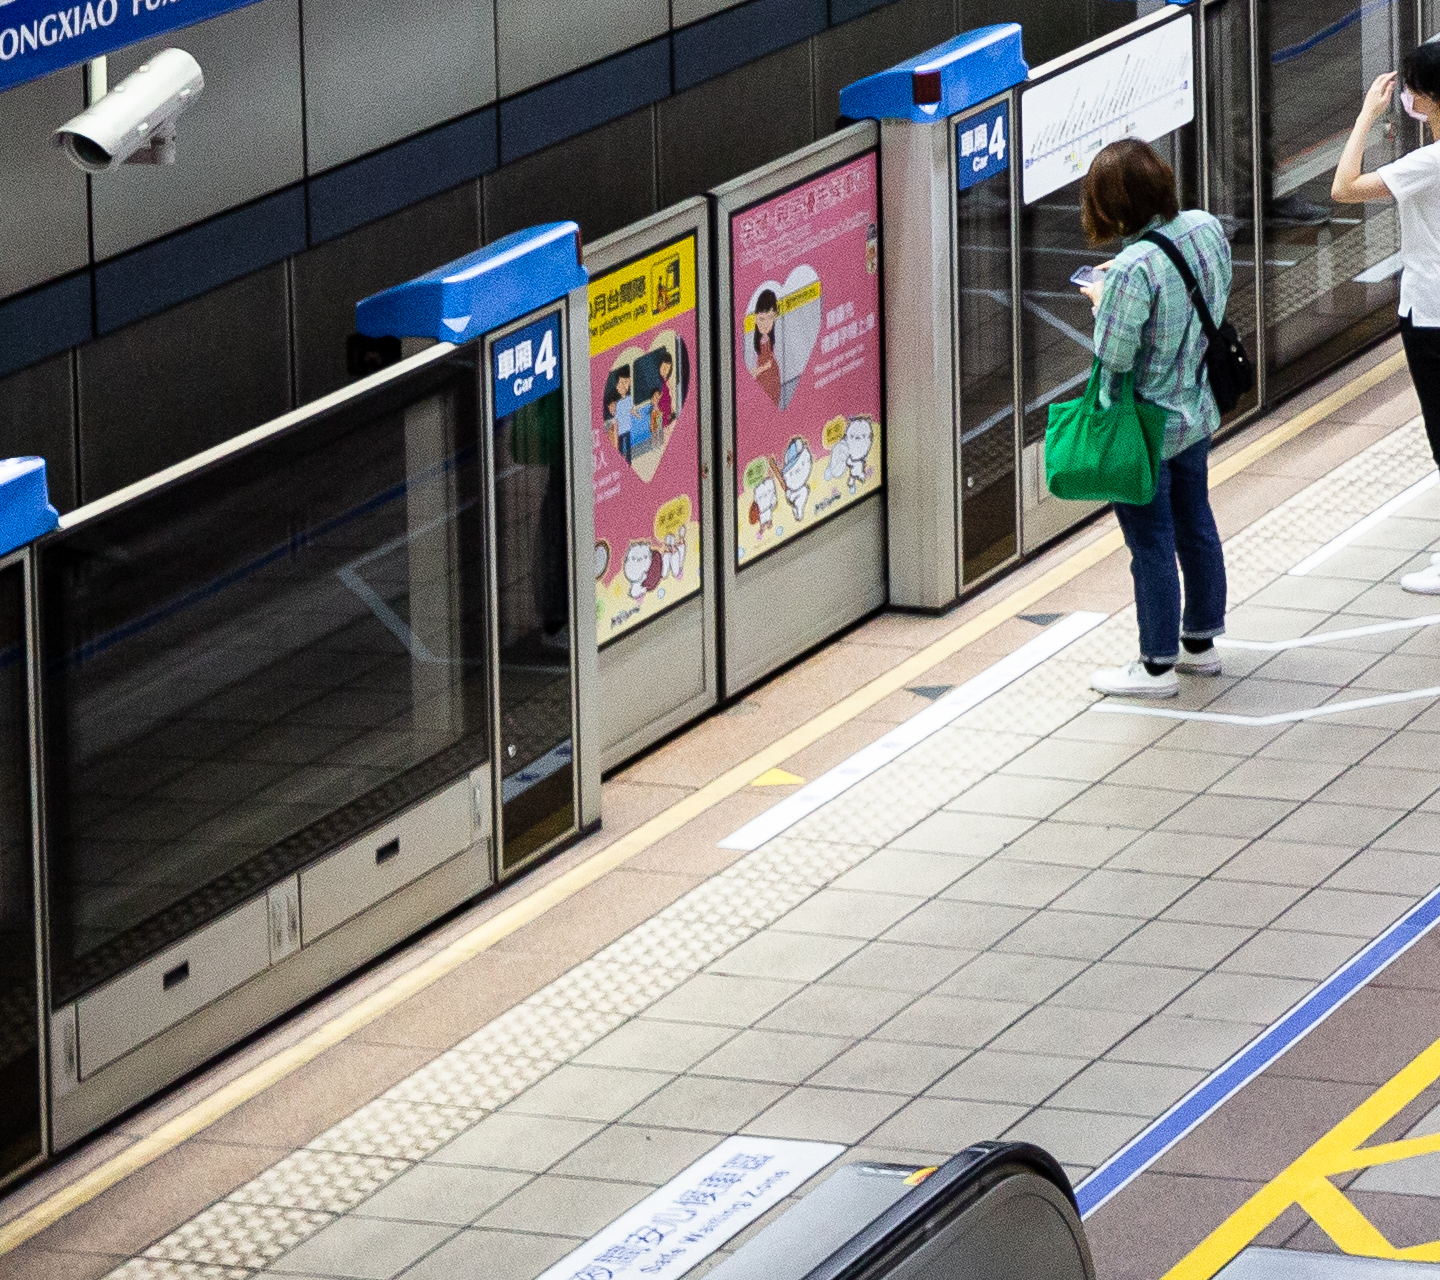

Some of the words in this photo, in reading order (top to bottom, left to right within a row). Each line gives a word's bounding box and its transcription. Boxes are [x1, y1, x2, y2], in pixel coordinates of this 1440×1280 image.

[988, 115, 1006, 161] 4
[972, 155, 989, 173] Car
[497, 339, 532, 383] 車廂
[534, 329, 557, 381] 4
[513, 375, 533, 397] Car
